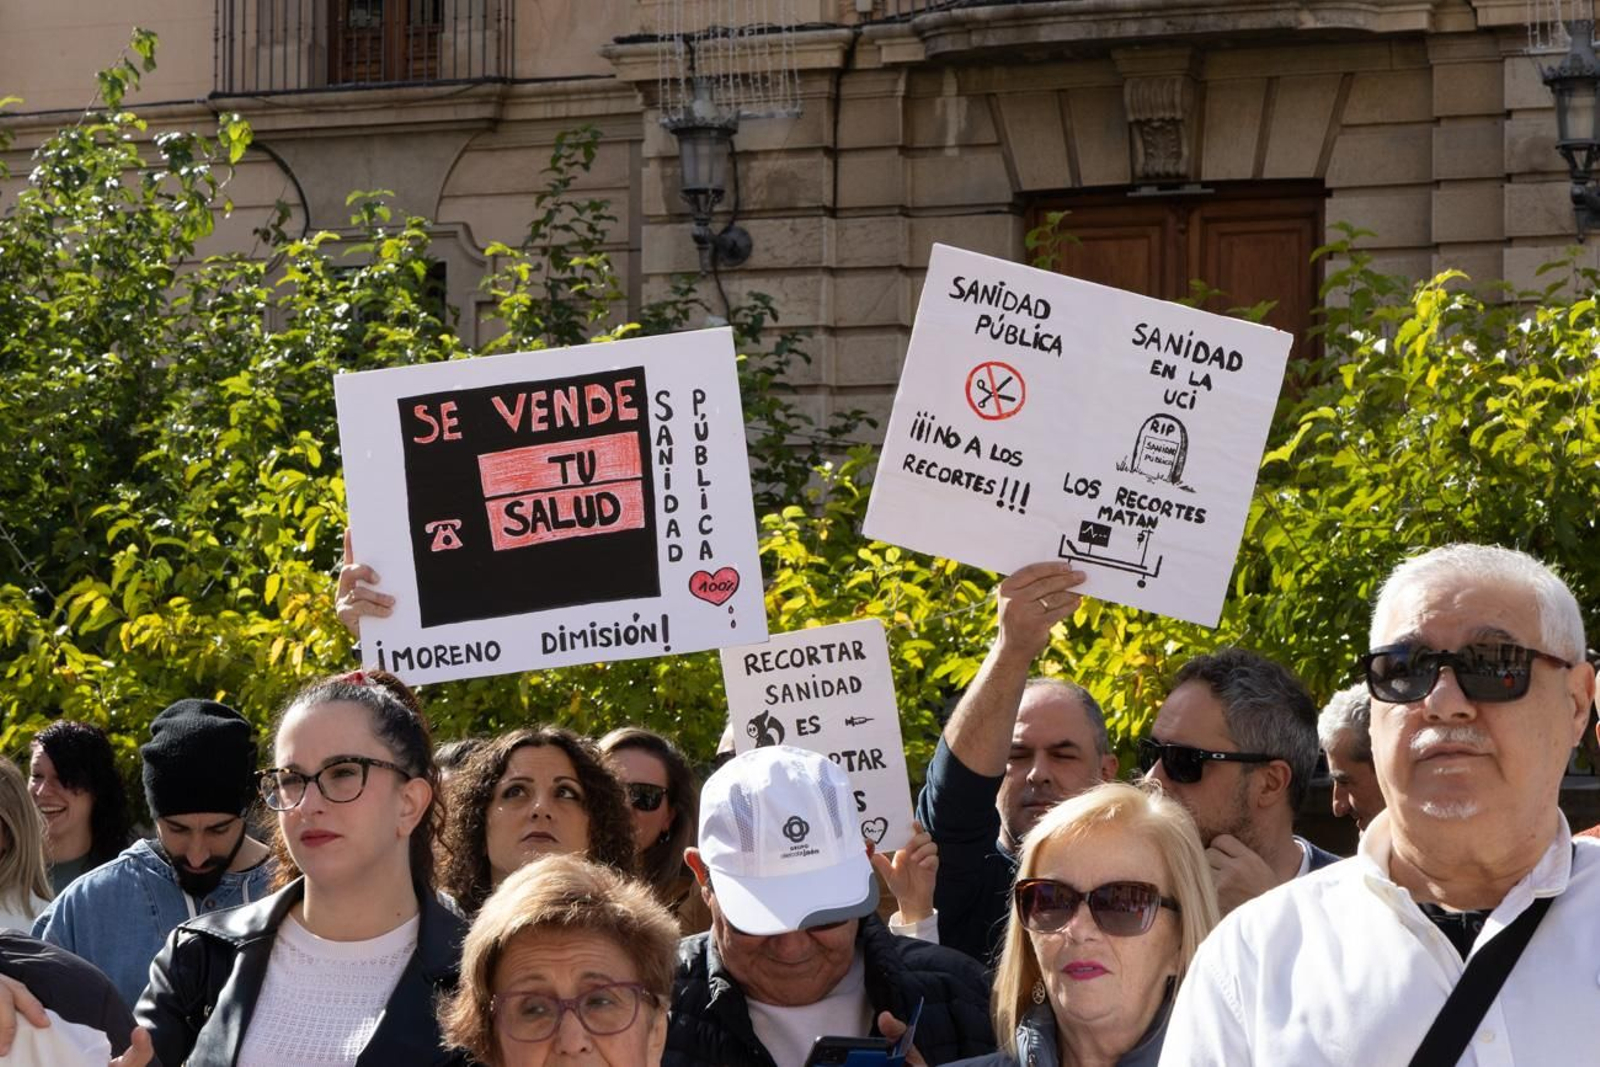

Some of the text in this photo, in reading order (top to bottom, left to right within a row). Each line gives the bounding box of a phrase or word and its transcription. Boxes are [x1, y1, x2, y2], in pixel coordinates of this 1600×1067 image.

[1150, 360, 1213, 391] EN LA
[413, 378, 640, 444] SE VENDE
[1150, 419, 1175, 436] RIP
[547, 450, 597, 485] TU
[965, 437, 981, 459] A
[989, 443, 1024, 467] LOS
[902, 454, 1031, 515] RECORTES!!!
[1063, 472, 1207, 525] LOS RECORTES
[503, 490, 621, 537] SALUD
[1097, 505, 1159, 530] MATAN
[698, 580, 735, 592] 100%
[743, 640, 867, 676] RECORTAR
[796, 715, 821, 736] ES
